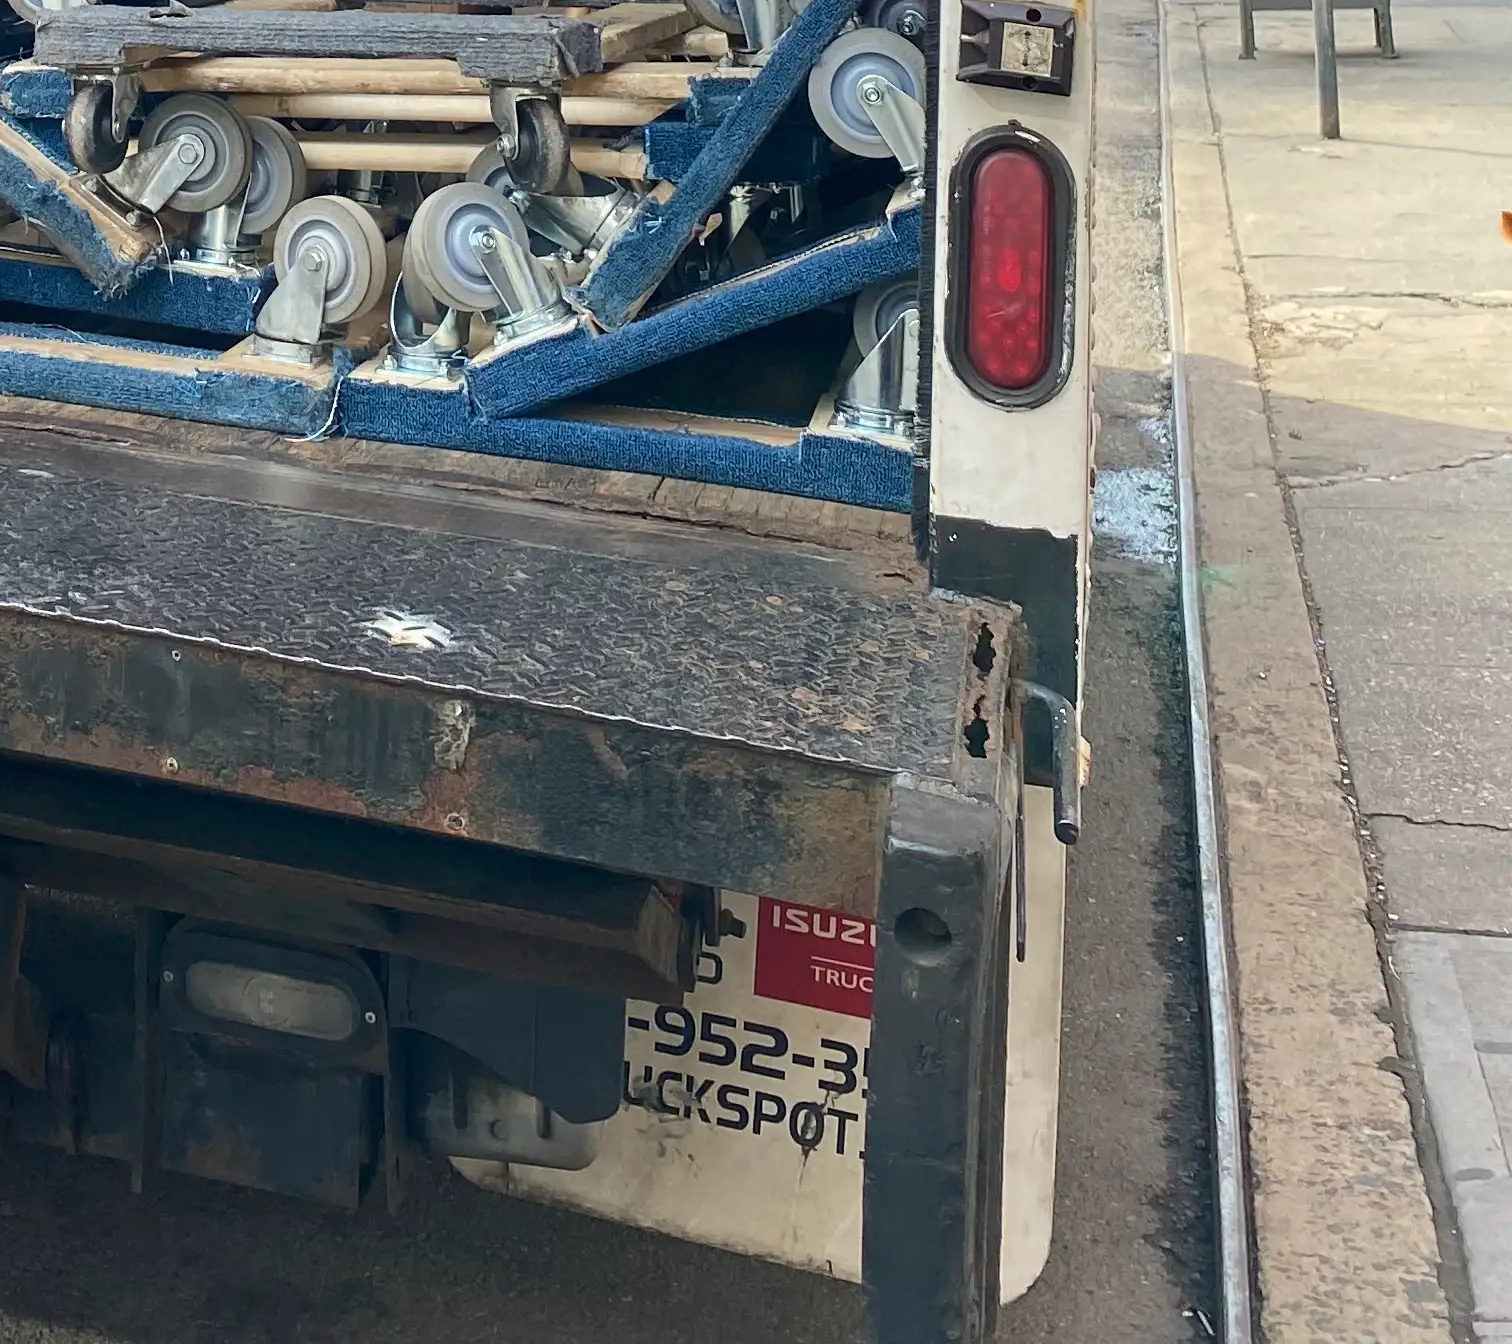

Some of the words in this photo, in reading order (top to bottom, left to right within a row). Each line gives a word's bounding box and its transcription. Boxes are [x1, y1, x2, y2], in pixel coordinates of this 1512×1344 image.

[810, 964, 874, 994] TRUC
[627, 1004, 870, 1100] -952-3
[622, 1059, 866, 1160] UCKSPOT.
